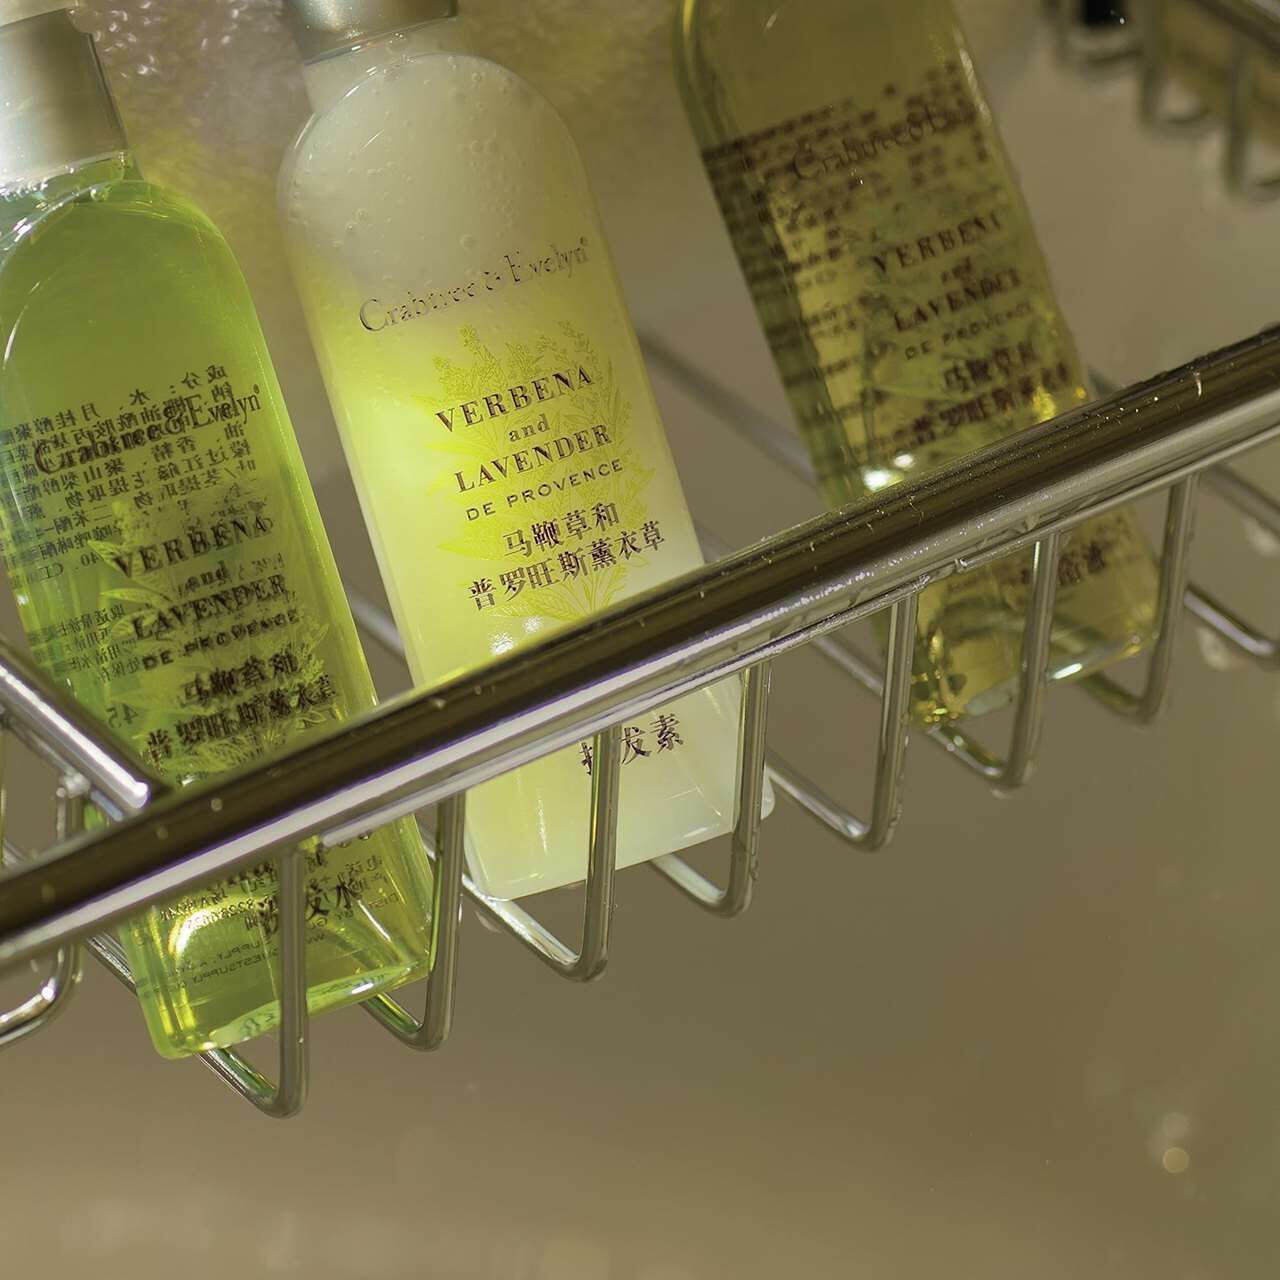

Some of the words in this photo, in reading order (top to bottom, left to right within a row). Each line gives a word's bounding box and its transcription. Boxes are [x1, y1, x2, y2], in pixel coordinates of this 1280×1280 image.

[359, 276, 475, 333] Crabtree
[505, 241, 589, 284] Evelyn
[435, 365, 594, 433] VERBENA
[509, 413, 551, 443] and
[34, 418, 161, 474] Crabtree
[185, 391, 261, 430] Evelyn
[454, 423, 613, 495] LAVENDER
[467, 502, 496, 521] DE
[506, 458, 623, 509] PROVENCE
[113, 516, 272, 578] VERBENA
[502, 501, 620, 559] 马鞭草和
[185, 560, 229, 591] and
[468, 520, 666, 611] 普罗旺斯薰衣草
[133, 573, 288, 641] LAVENDER
[144, 654, 174, 672] DE
